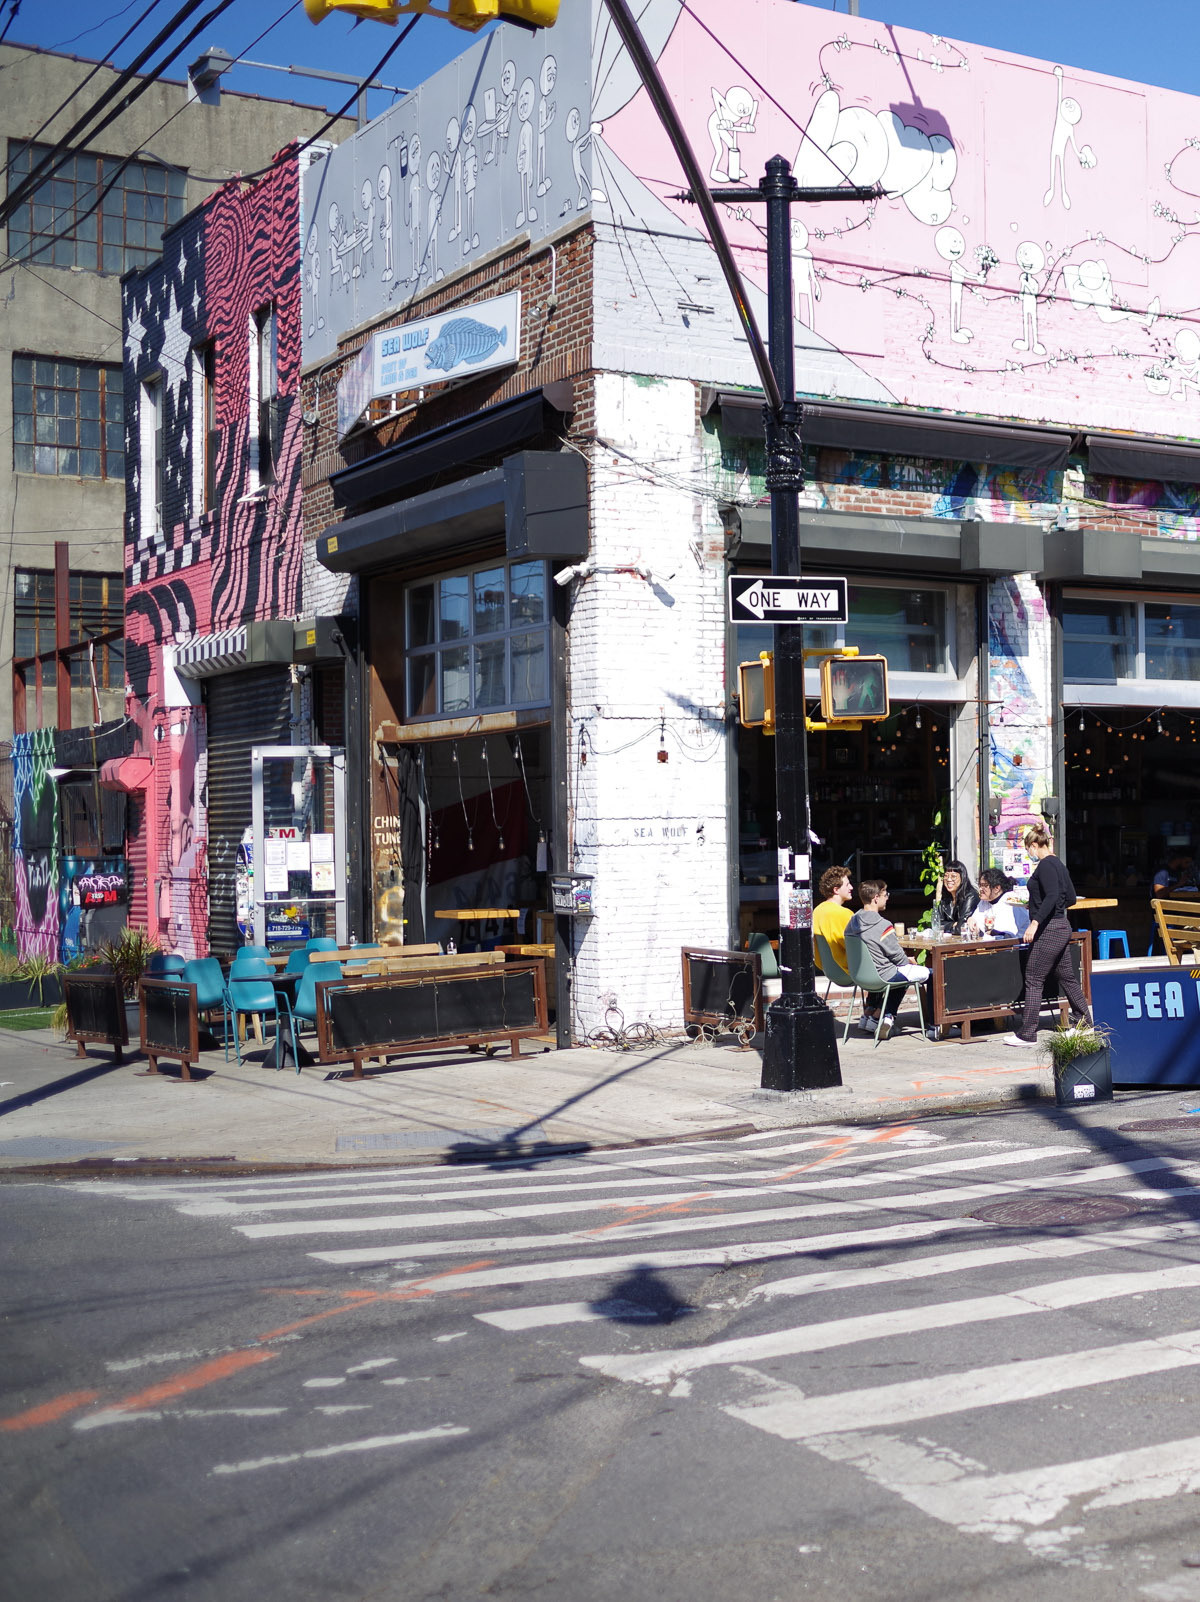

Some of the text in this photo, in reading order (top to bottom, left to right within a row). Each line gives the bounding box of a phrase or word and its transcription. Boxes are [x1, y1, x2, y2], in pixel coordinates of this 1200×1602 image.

[382, 328, 429, 357] SEA WOLF
[749, 591, 830, 608] ONE WAY
[634, 828, 653, 838] SEA
[1124, 981, 1185, 1018] SEA
